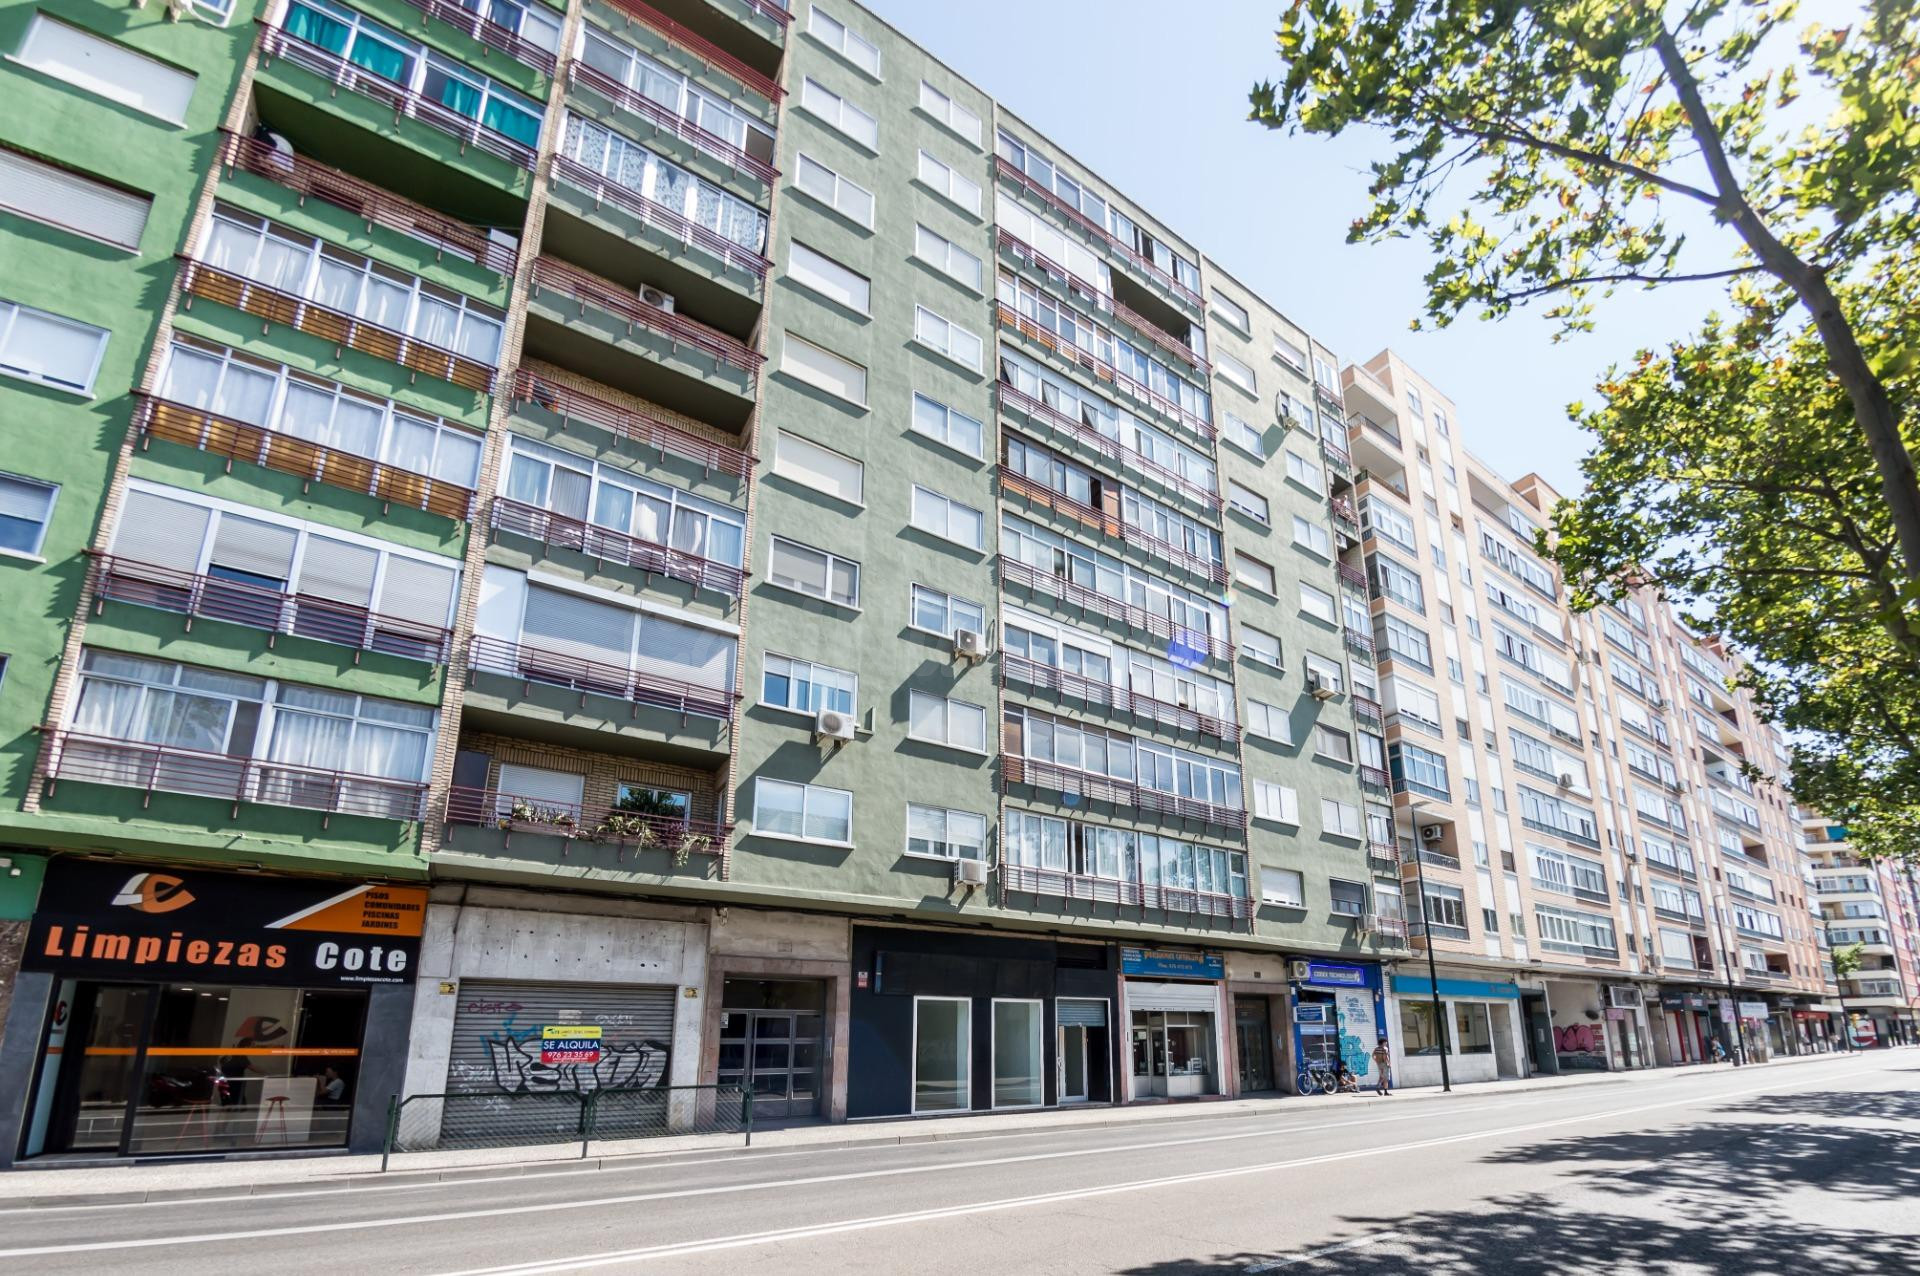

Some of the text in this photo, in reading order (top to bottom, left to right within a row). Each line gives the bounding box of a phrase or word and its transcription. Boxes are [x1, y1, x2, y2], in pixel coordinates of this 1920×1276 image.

[366, 892, 389, 900] PISOS
[364, 901, 420, 911] COMUNIDADES
[363, 911, 400, 919] PISCINAS
[362, 921, 399, 929] JARDINES
[44, 925, 407, 972] Limpiezas Cote
[543, 1040, 599, 1050] SE ALQUILA
[547, 1051, 562, 1059] 976
